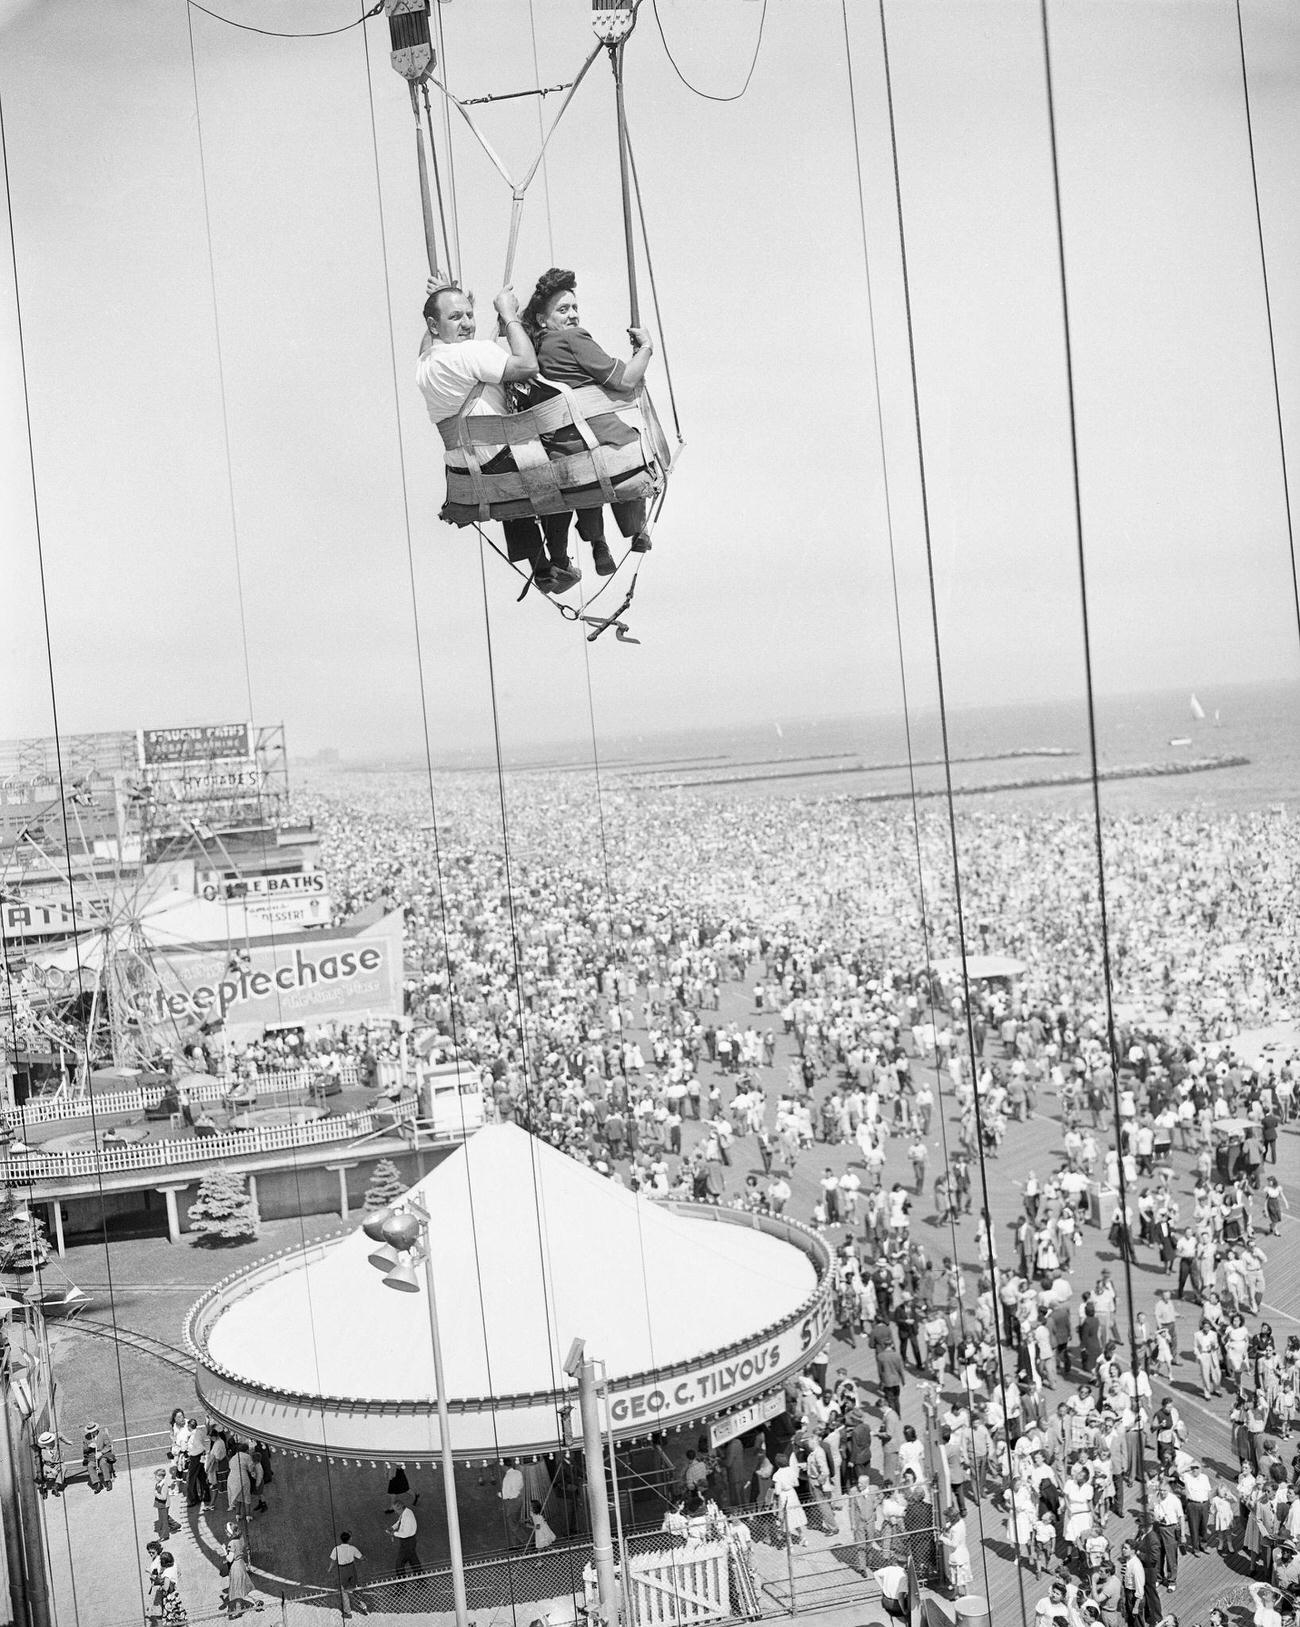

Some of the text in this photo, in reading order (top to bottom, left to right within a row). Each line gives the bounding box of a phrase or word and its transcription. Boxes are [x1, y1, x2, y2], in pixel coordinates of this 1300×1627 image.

[268, 875, 324, 892] BATHS
[611, 1390, 670, 1421] GEO.
[674, 1383, 695, 1405] C.
[696, 1345, 781, 1398] TILYOU'S
